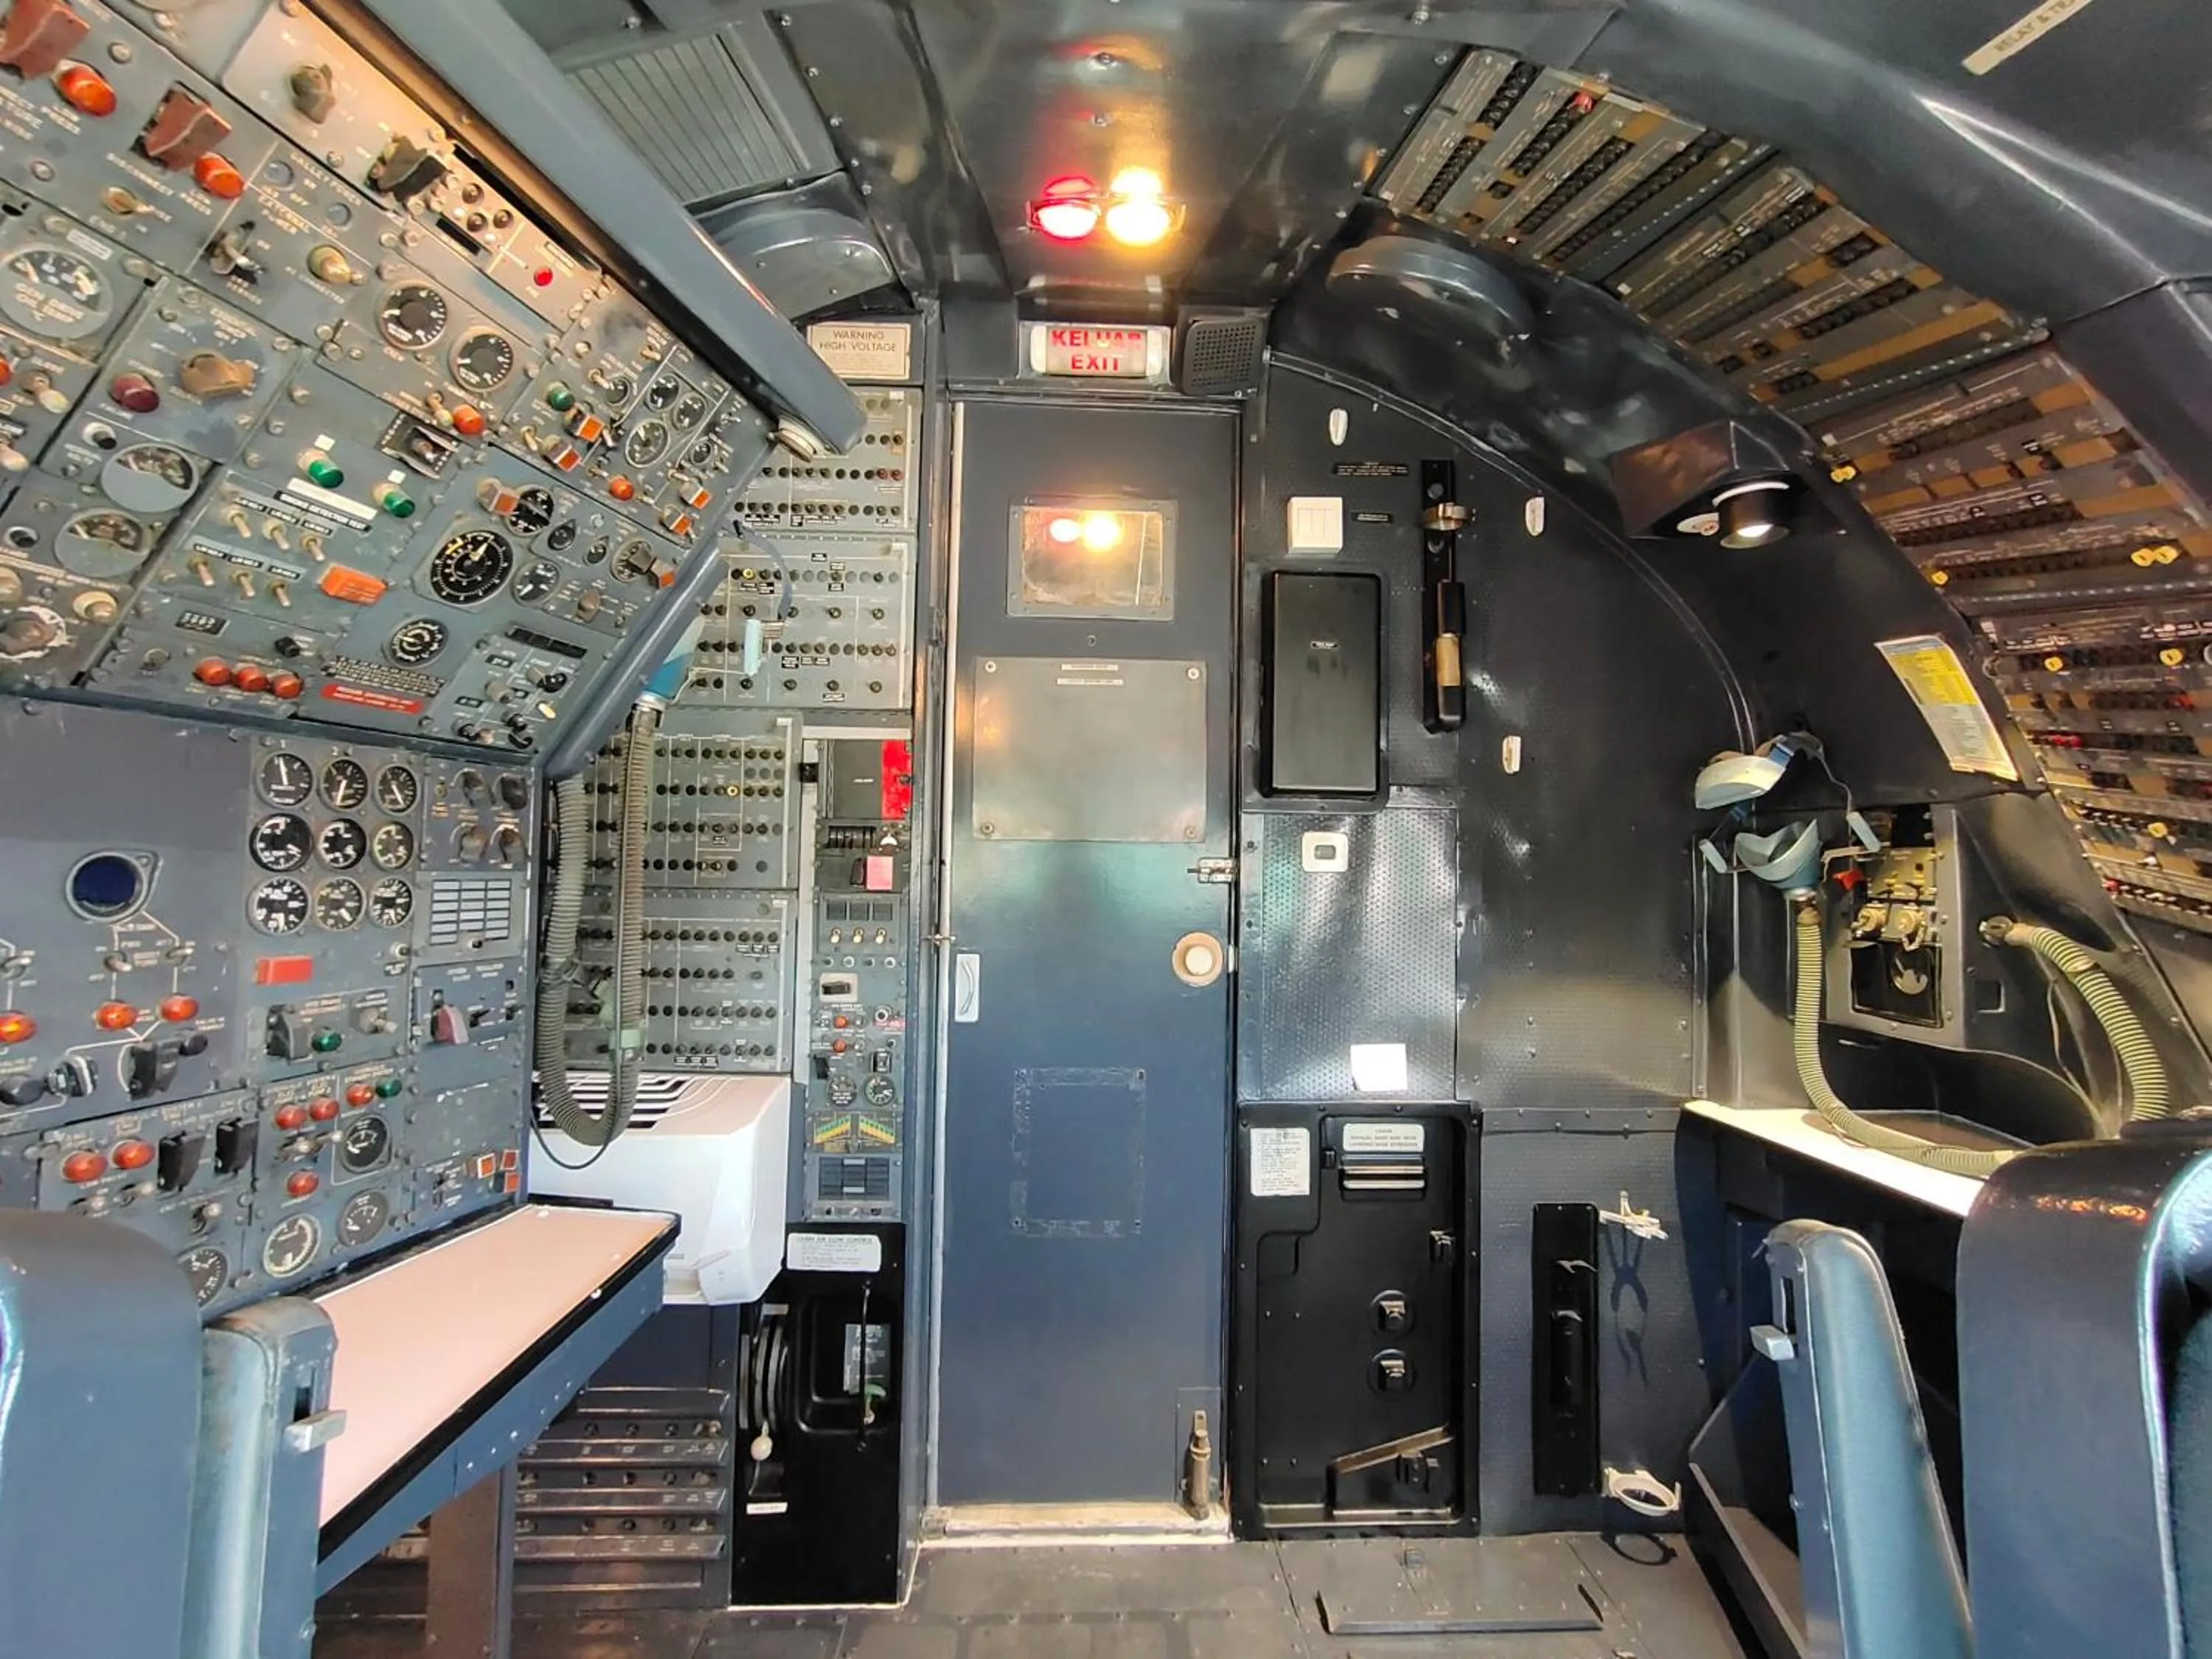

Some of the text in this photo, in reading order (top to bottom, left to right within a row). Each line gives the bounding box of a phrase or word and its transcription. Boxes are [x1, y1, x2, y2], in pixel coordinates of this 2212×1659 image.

[832, 330, 885, 340] WARNING
[819, 341, 896, 352] HIGH VOLTAGE
[1071, 354, 1124, 371] EXIT
